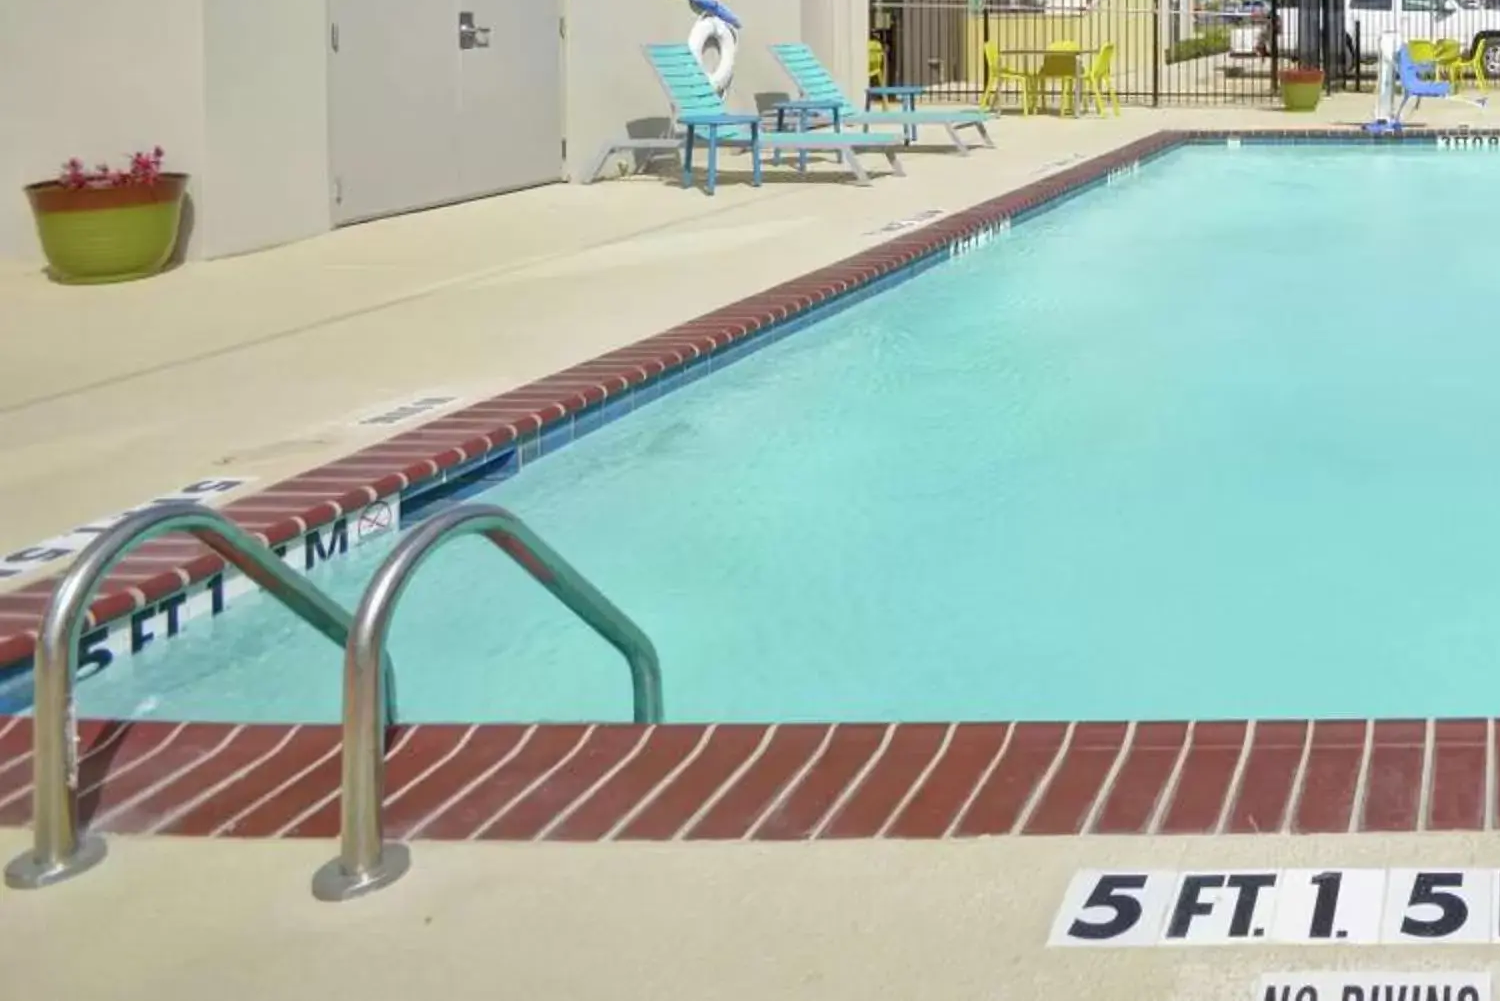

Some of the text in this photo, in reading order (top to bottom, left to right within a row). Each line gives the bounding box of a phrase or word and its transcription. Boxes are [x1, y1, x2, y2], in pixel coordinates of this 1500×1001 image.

[304, 515, 349, 571] M
[131, 593, 187, 656] FT
[206, 571, 225, 615] 1
[1066, 874, 1149, 939] 5
[1400, 872, 1470, 938] 5
